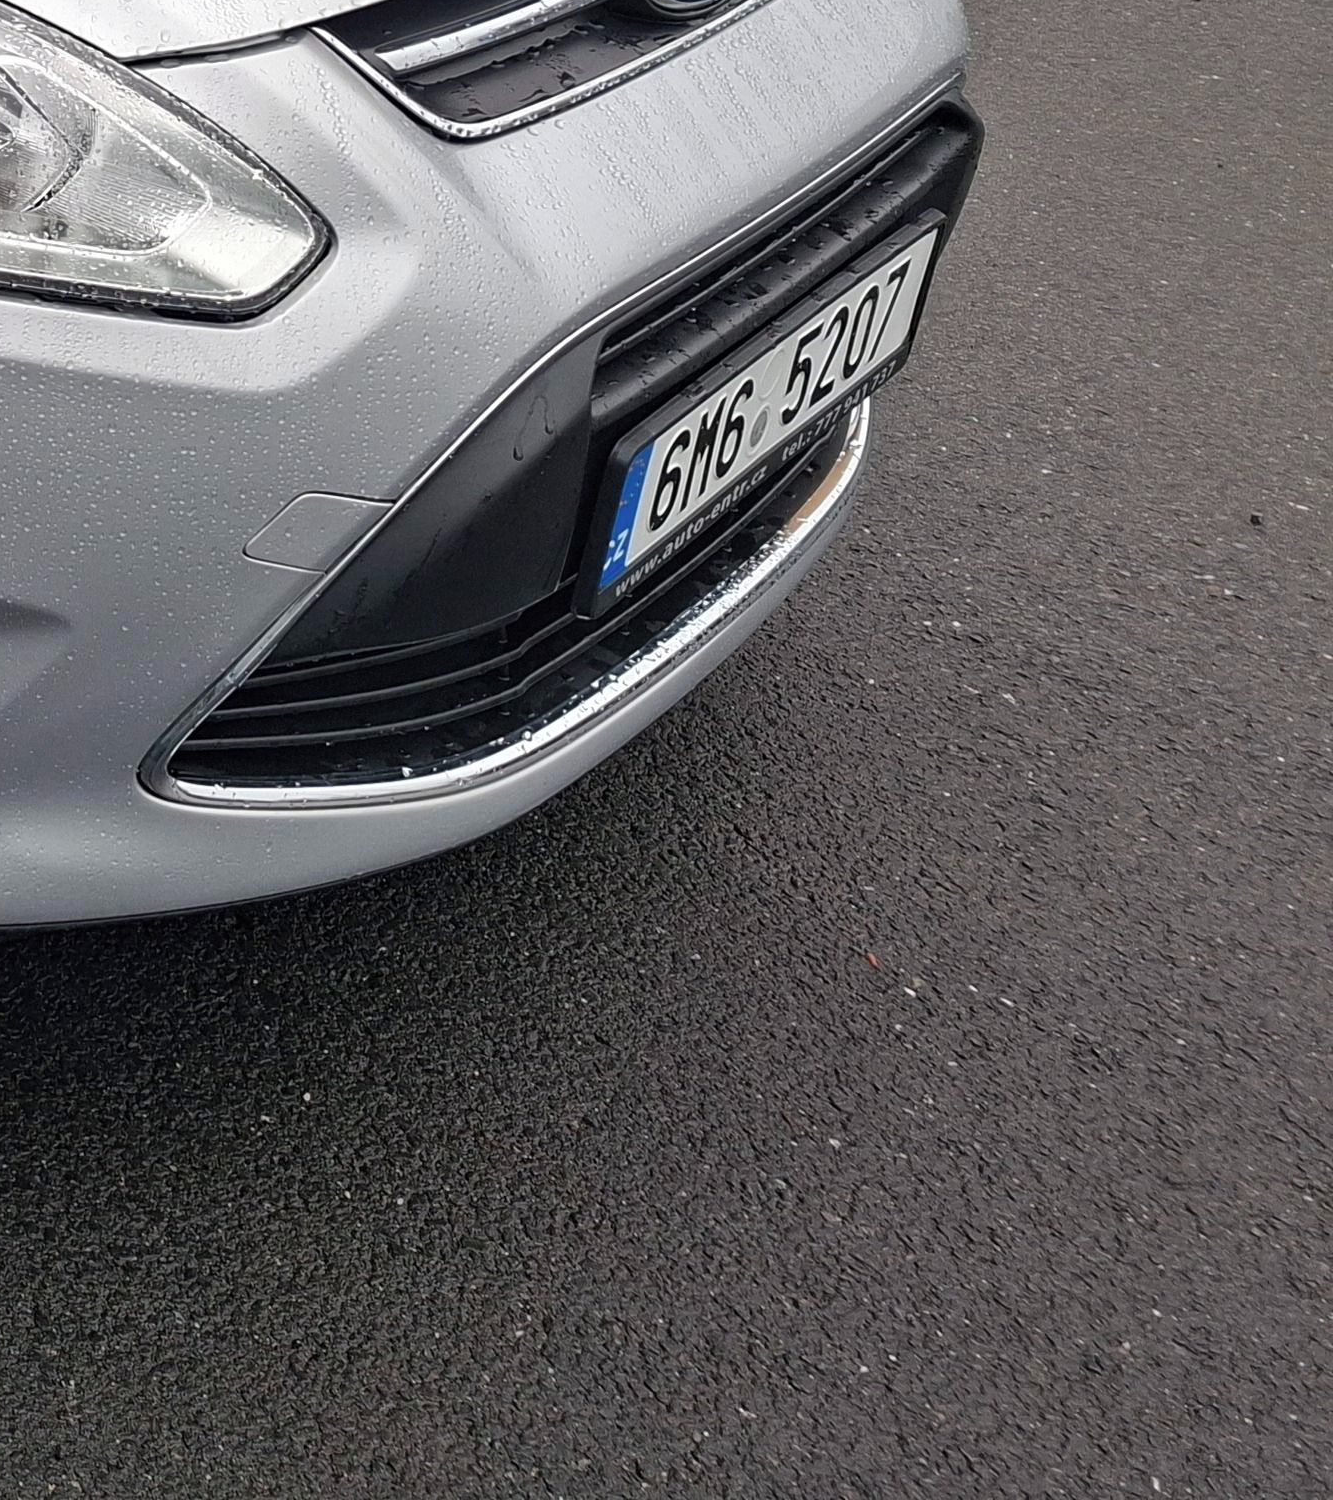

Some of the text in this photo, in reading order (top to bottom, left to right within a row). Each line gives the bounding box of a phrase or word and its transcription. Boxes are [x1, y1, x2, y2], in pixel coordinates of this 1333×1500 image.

[648, 258, 912, 532] 6M6 5207
[616, 465, 768, 597] www.auto-entr.cz
